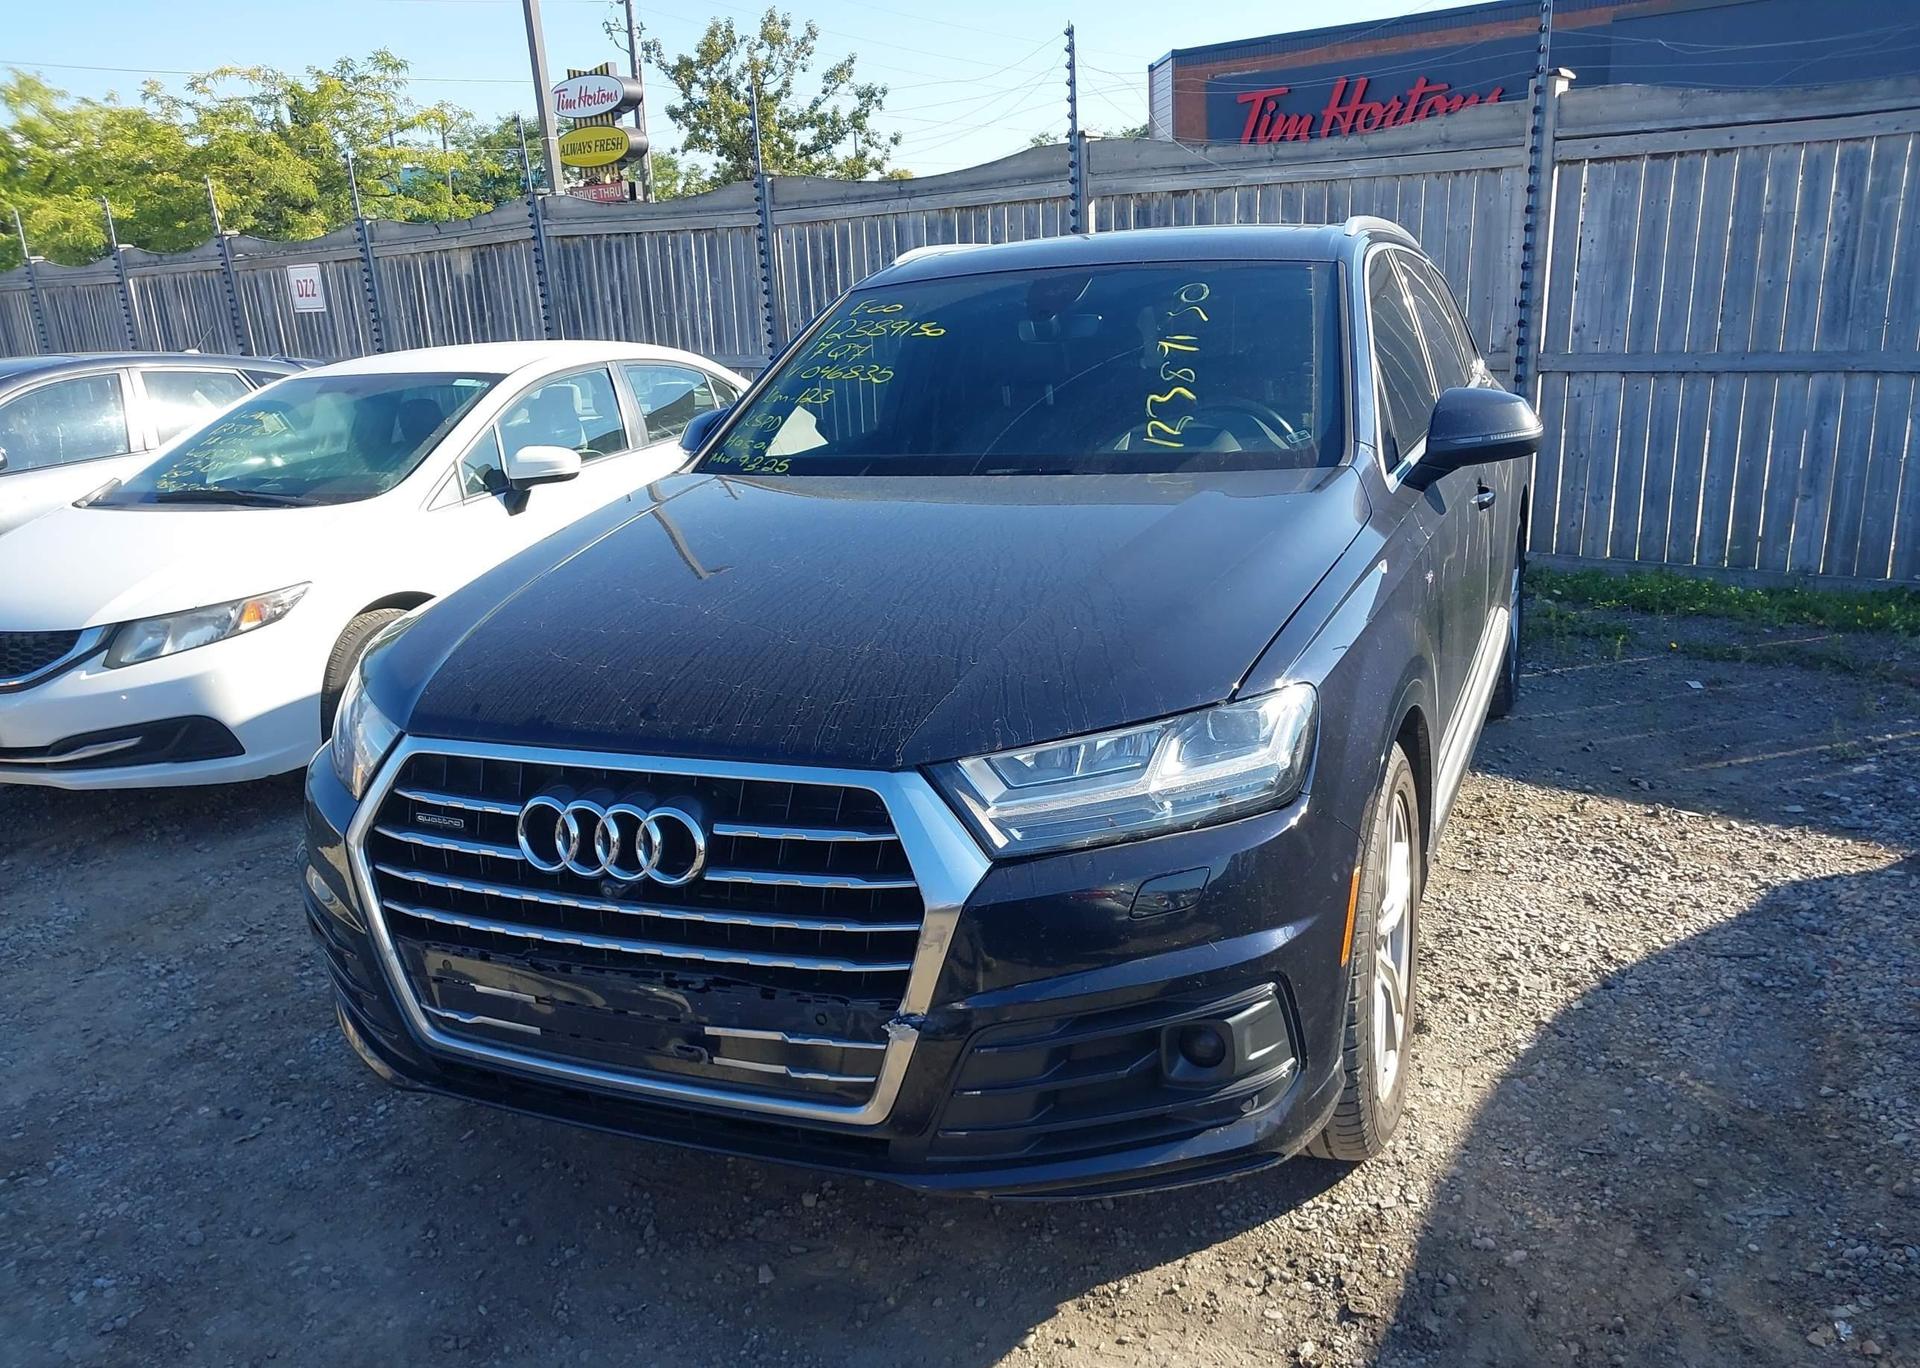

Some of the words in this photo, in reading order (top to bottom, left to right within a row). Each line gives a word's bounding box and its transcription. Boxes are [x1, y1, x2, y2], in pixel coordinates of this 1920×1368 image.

[554, 87, 577, 112] Tim
[578, 85, 618, 110] Hortons
[1237, 87, 1314, 144] Tim
[560, 141, 593, 157] ALWAYS
[594, 137, 623, 153] FRESH
[599, 185, 621, 198] THRU
[296, 279, 317, 298] DZ2
[417, 815, 461, 826] quattro
